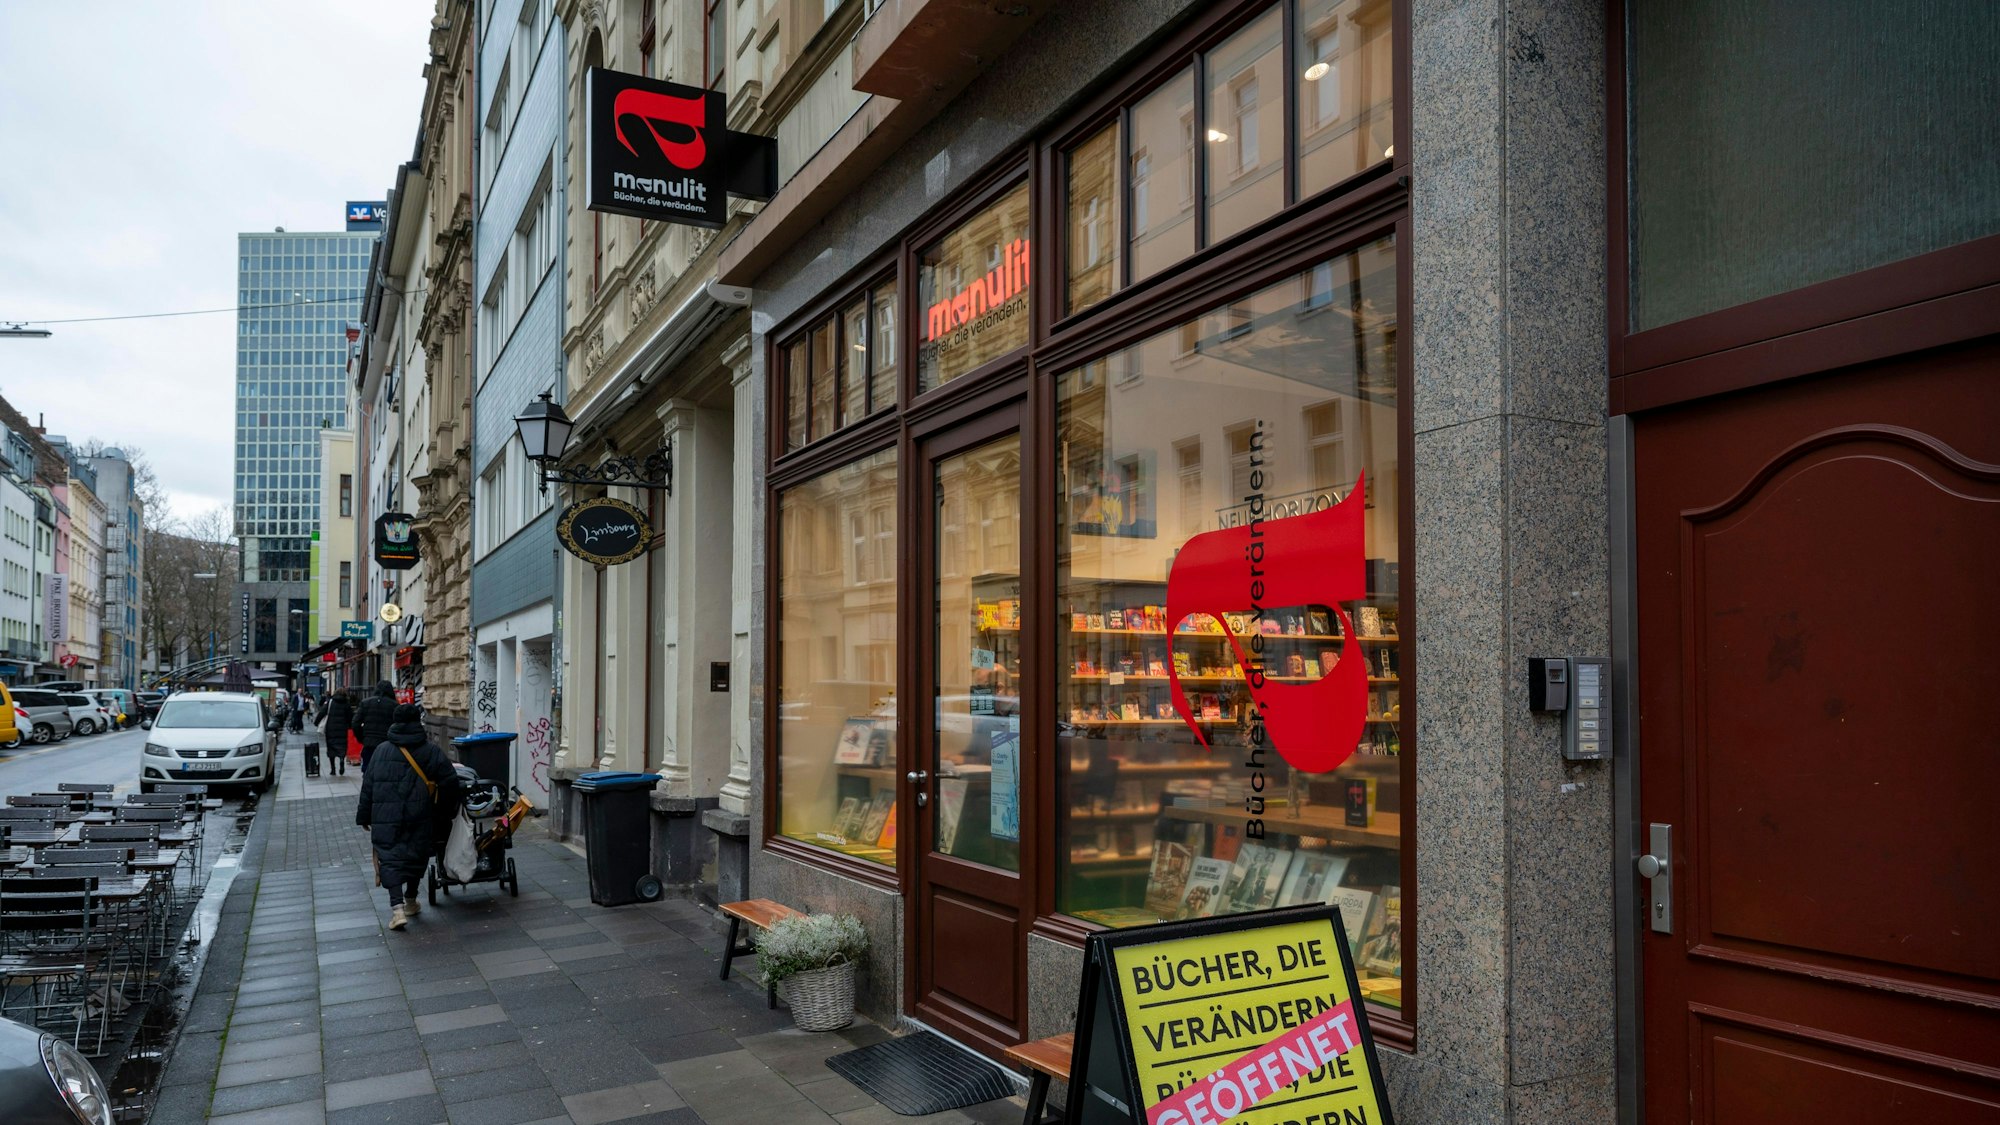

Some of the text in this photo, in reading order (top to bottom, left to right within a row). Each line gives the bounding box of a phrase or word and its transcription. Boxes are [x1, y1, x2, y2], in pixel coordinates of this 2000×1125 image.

[613, 171, 707, 202] manulit
[613, 191, 706, 214] Bücher, die verändern.
[954, 325, 969, 344] die
[970, 297, 1026, 337] verändern.
[1244, 420, 1268, 840] Bücher, die verändern.
[1332, 896, 1364, 909] EUROPA
[1131, 938, 1327, 996] BÜCHER, DIE
[1142, 993, 1338, 1053] VERÄNDERN
[1155, 1012, 1355, 1125] GEÖFFNET
